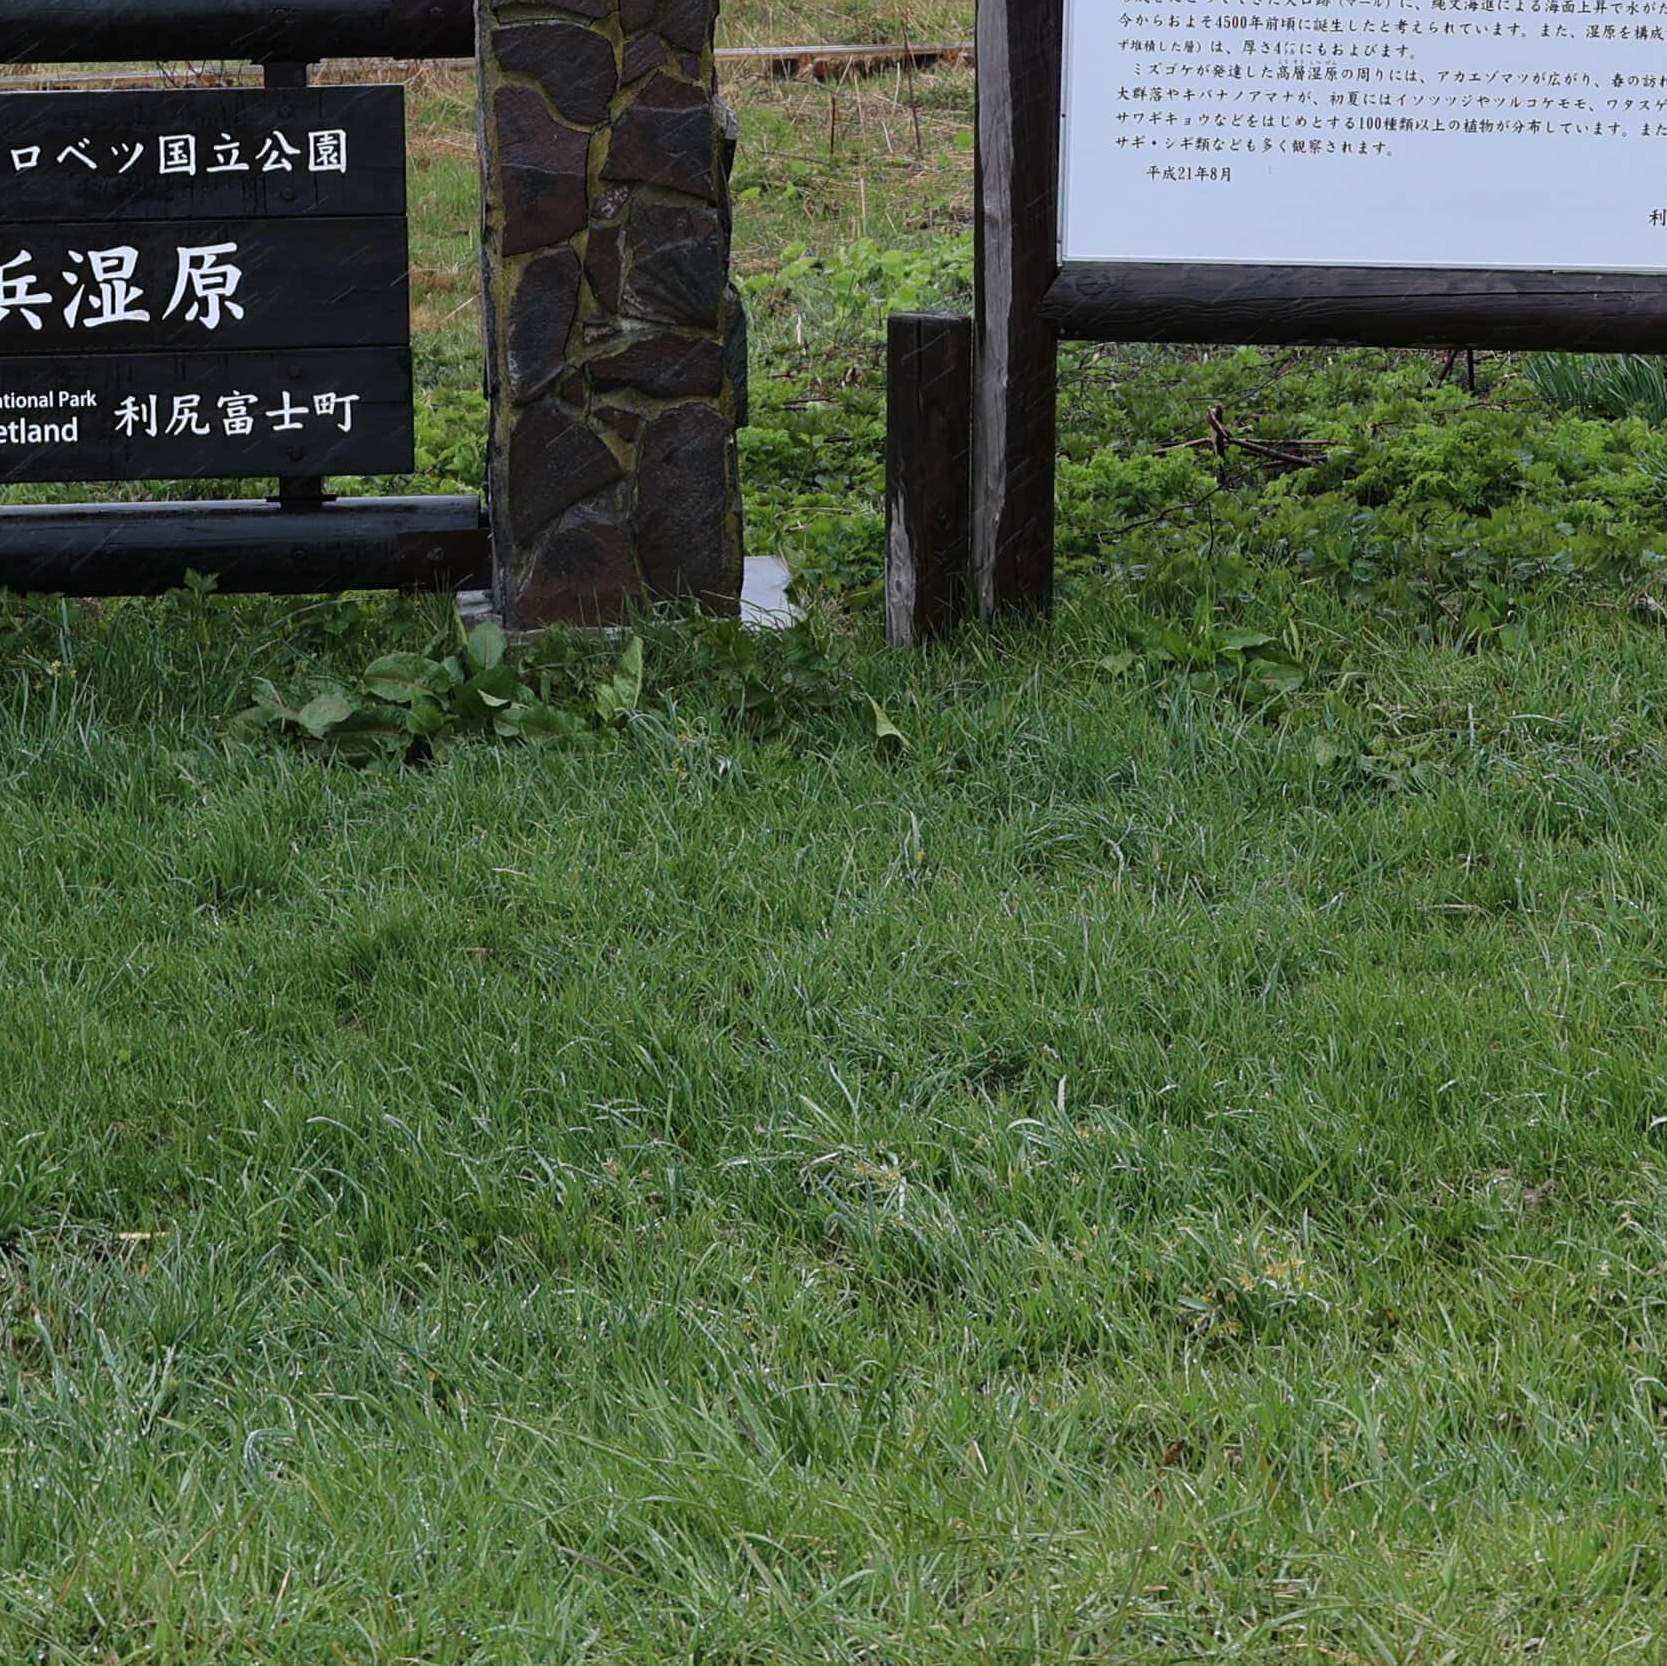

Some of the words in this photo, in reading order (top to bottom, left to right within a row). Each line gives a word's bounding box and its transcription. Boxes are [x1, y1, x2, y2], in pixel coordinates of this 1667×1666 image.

[1145, 165, 1232, 182] 平成21年8月
[58, 389, 97, 408] Park
[114, 389, 360, 438] 利尻富士町
